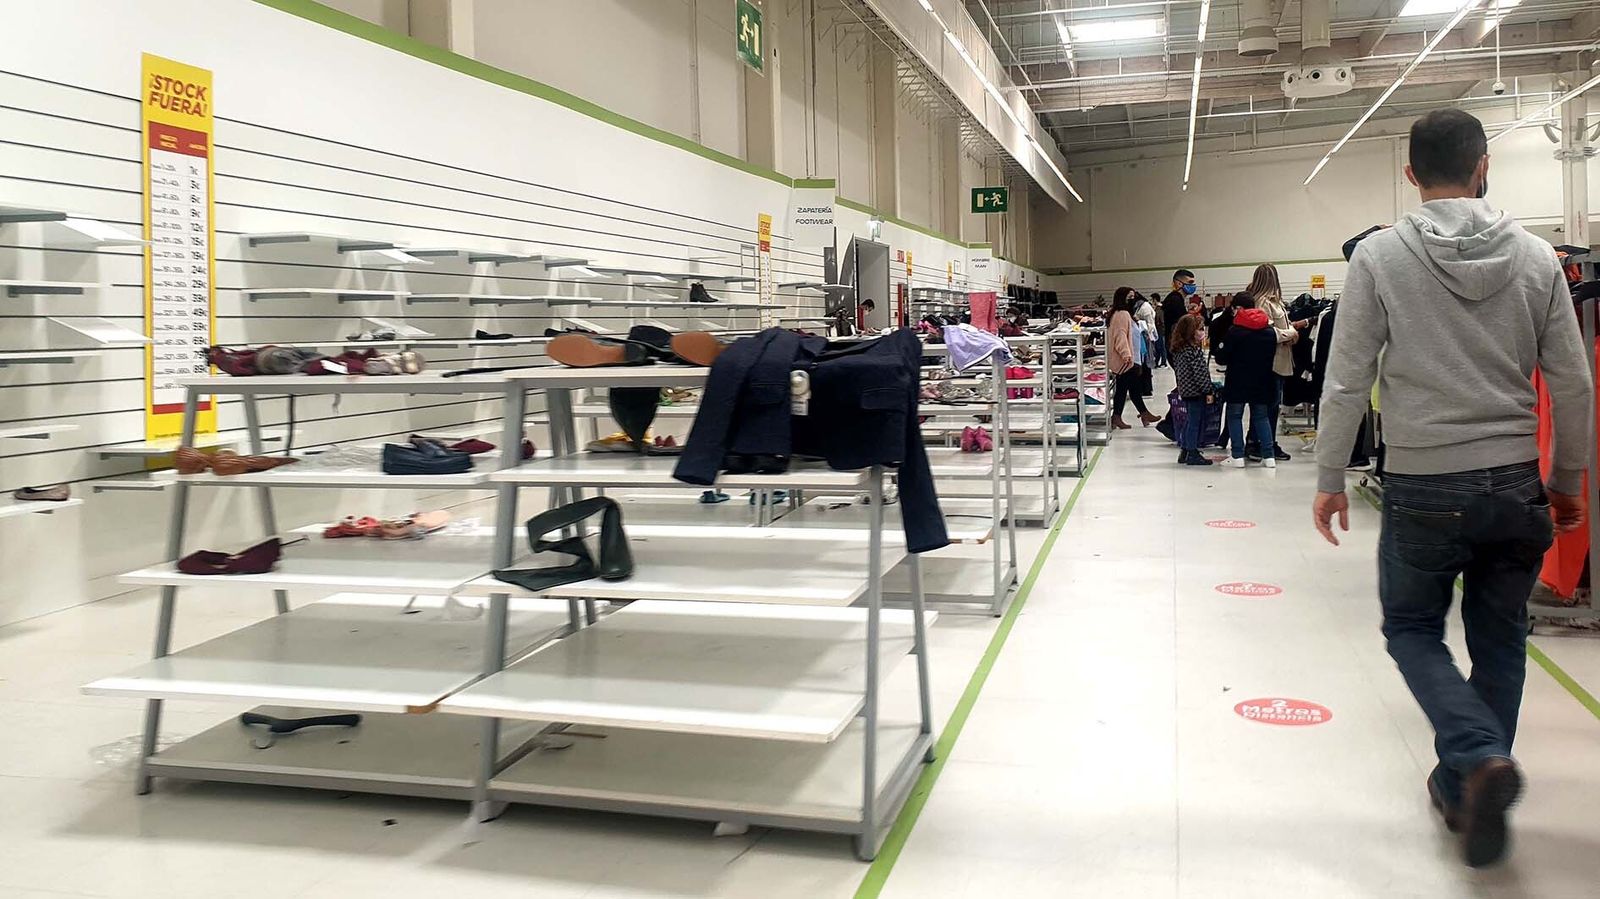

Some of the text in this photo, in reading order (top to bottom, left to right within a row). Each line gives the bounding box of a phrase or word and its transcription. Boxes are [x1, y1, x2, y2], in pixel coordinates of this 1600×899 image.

[149, 91, 208, 118] FUERA!
[797, 206, 833, 214] ZAPATERÍA
[1271, 699, 1287, 707] 2
[1241, 704, 1321, 716] Metros
[1242, 711, 1322, 722] Distancia
